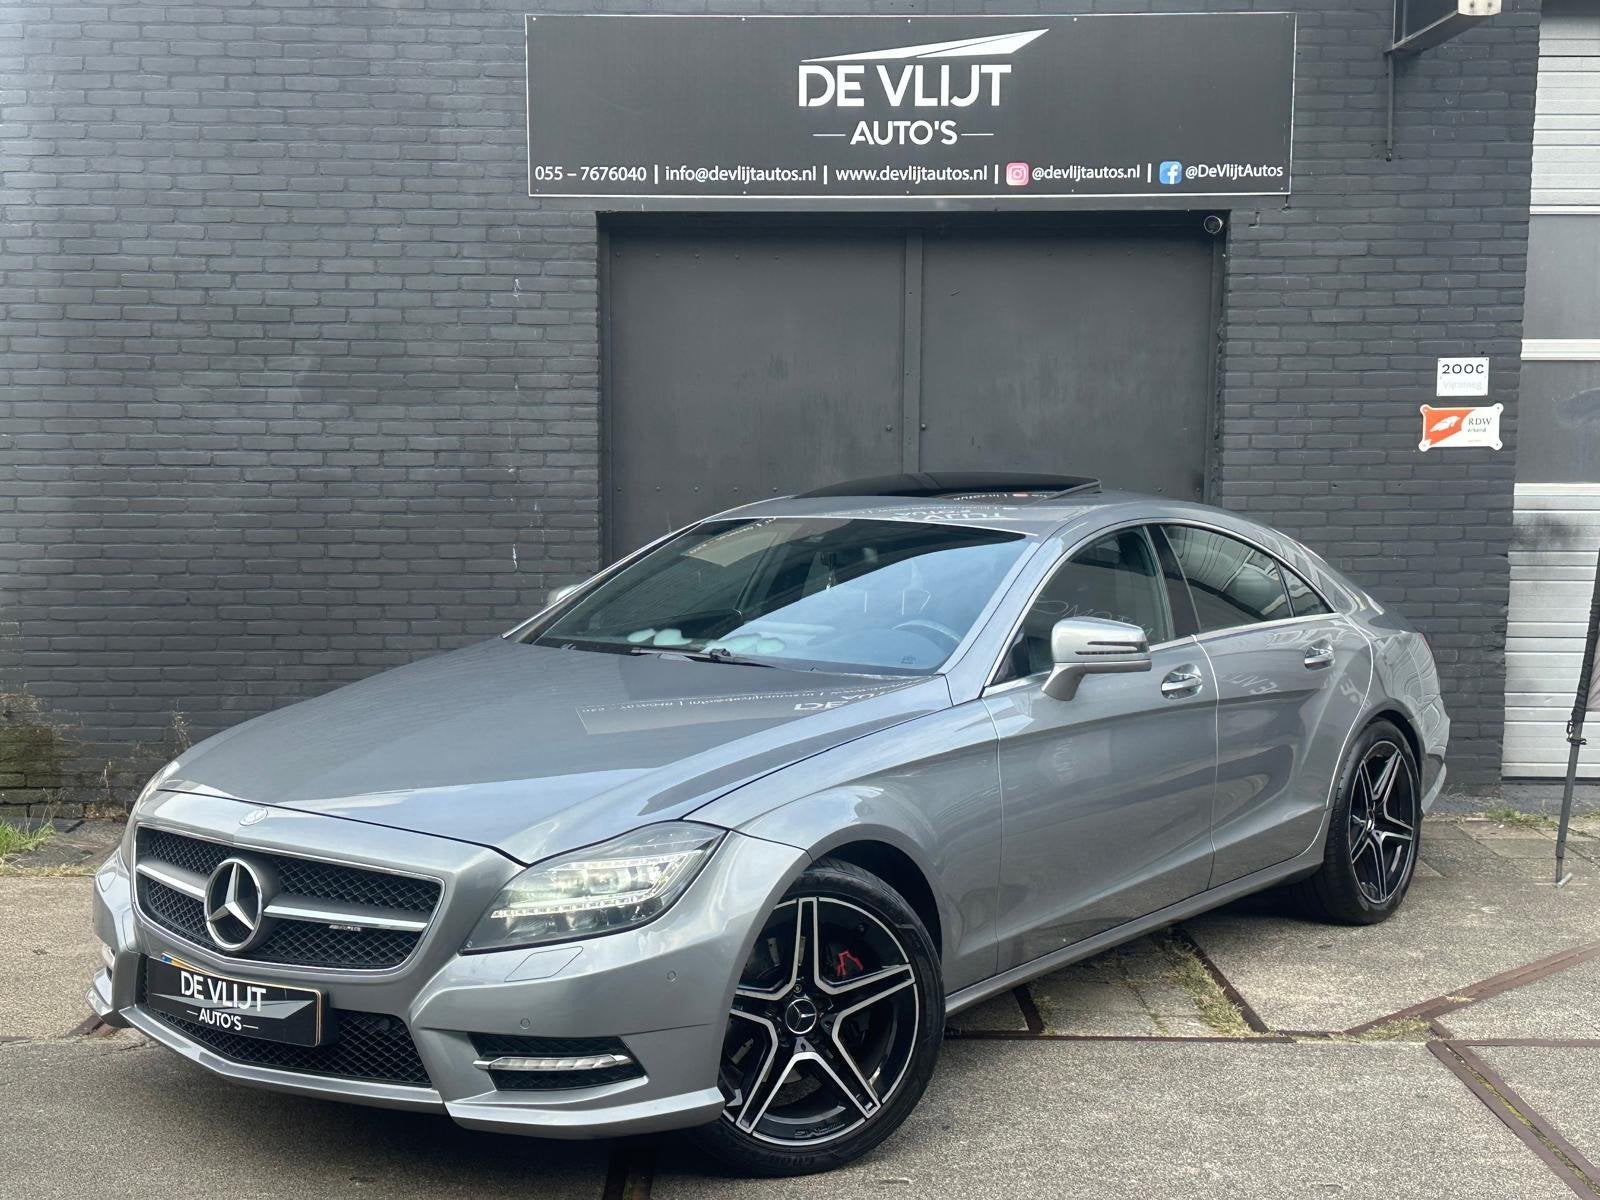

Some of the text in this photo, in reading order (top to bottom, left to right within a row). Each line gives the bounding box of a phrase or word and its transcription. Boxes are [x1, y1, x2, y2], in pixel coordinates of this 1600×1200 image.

[798, 64, 1012, 107] DE VLIJT
[850, 120, 958, 146] AUTO'S
[534, 165, 563, 181] 055
[580, 165, 647, 181] 7676040
[665, 165, 817, 184] info@devlijtautos.nl
[835, 165, 988, 184] www.devlijtautos.nl
[1032, 164, 1141, 183] @devlijtautos.nl
[1185, 163, 1283, 180] @DeVlijtAutos
[1468, 417, 1492, 425] RDW
[180, 970, 267, 1012] DE VLIJT
[198, 1008, 242, 1031] AUTO'S
